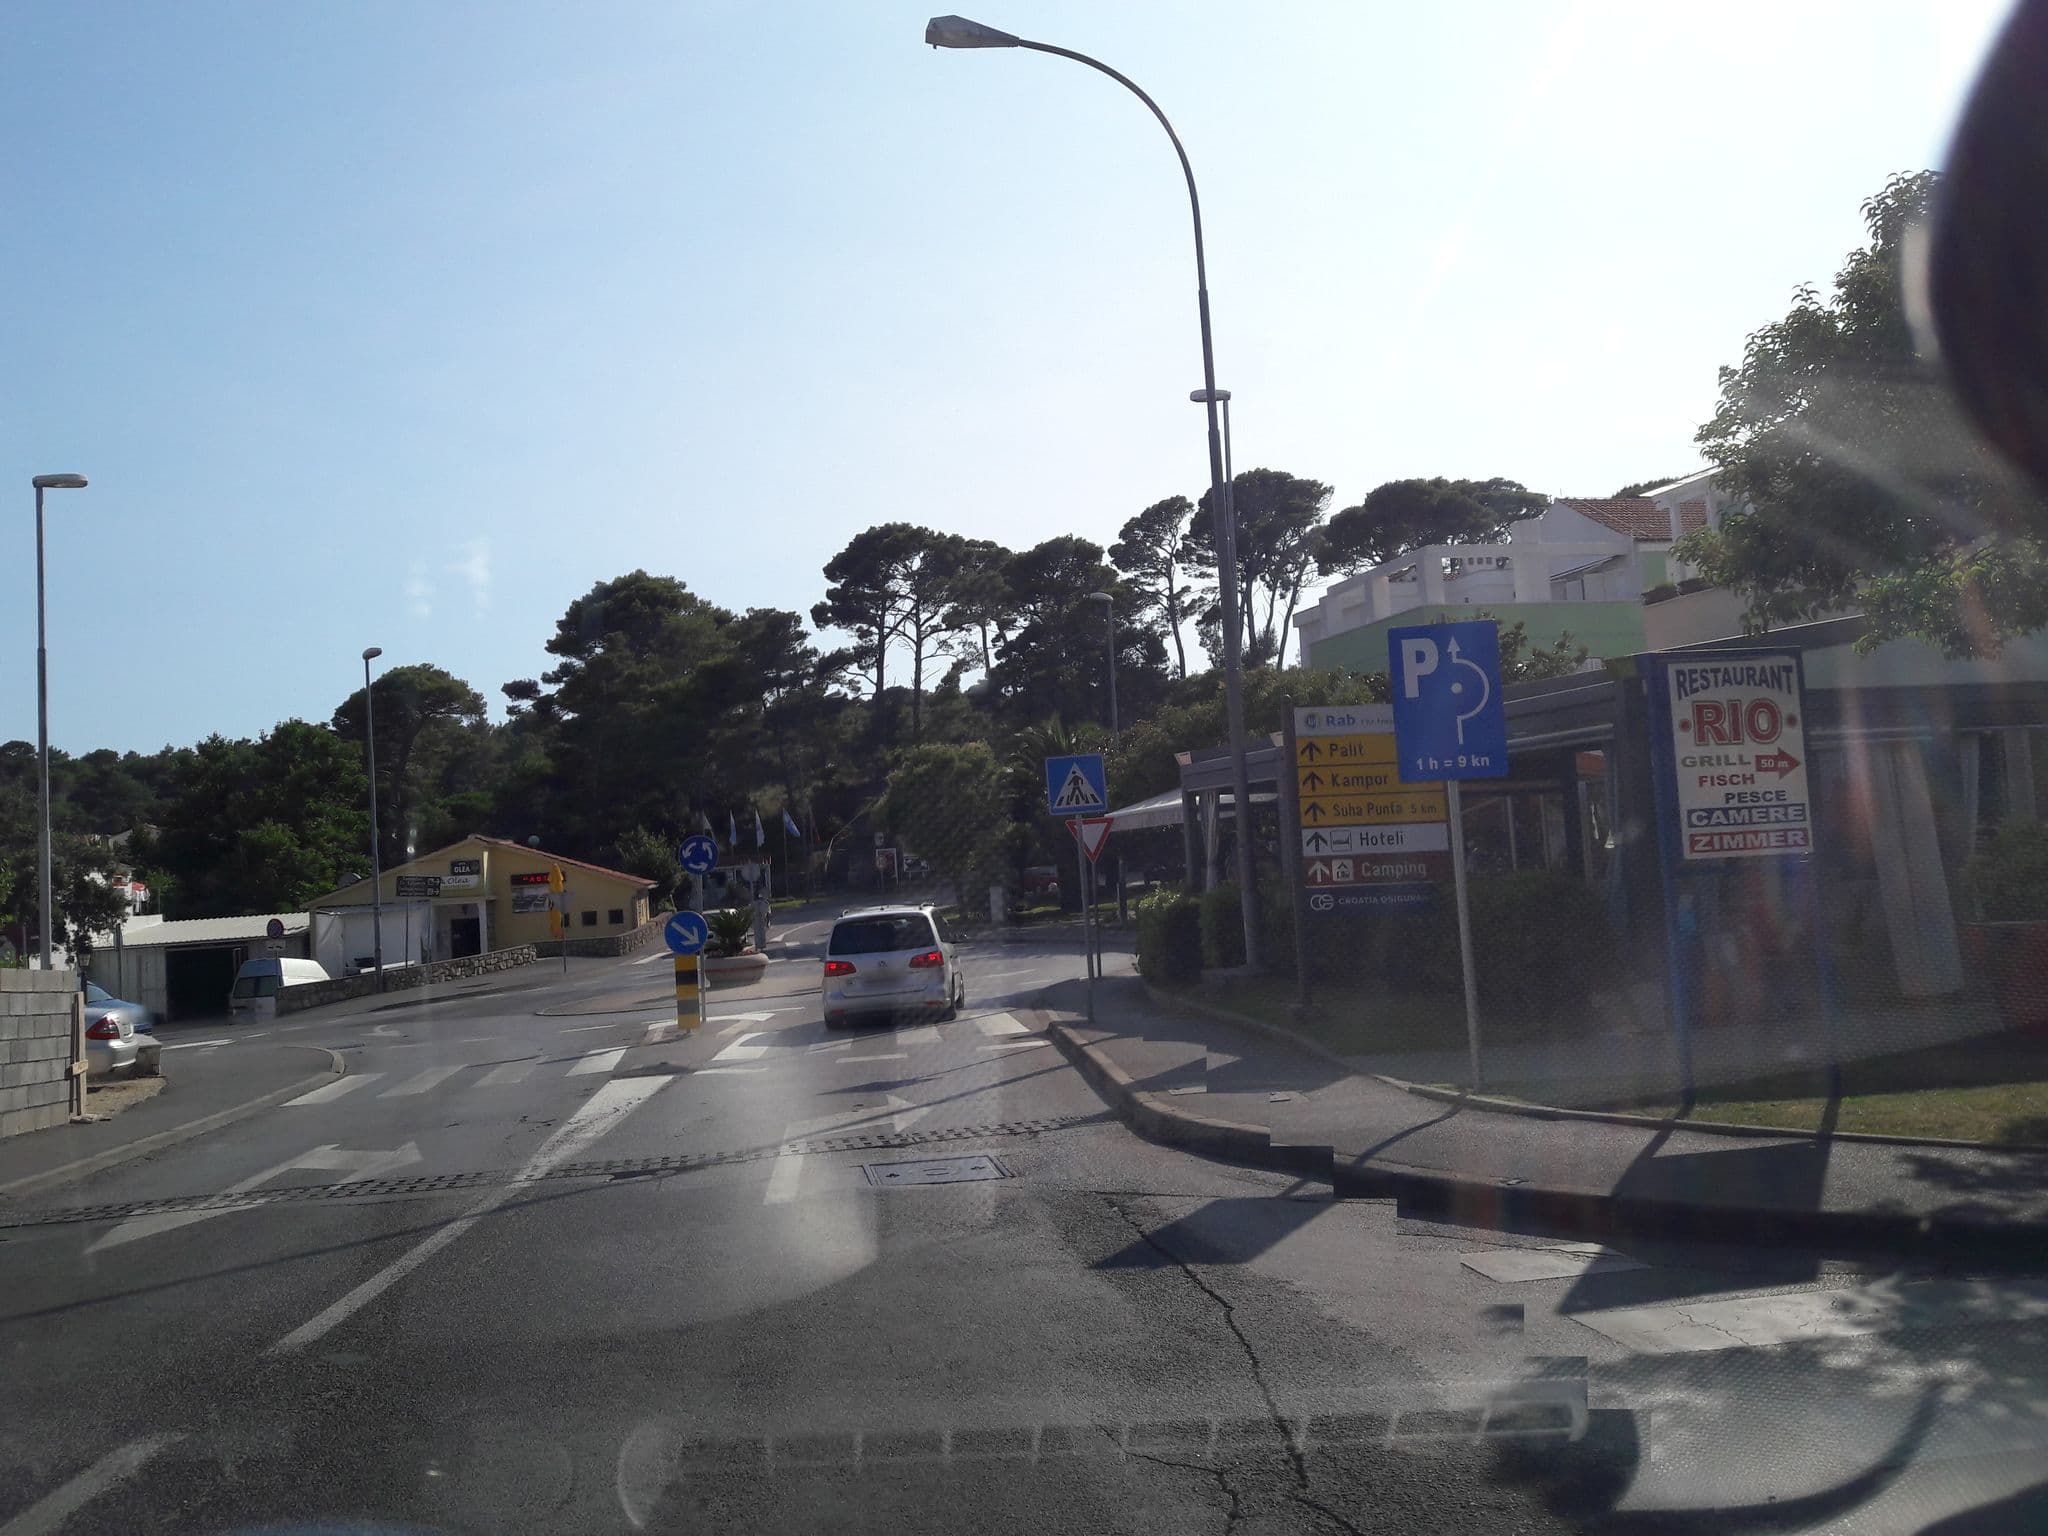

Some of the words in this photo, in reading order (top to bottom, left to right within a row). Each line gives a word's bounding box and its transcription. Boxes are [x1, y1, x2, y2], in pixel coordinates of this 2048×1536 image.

[1401, 637, 1439, 699] P
[1676, 664, 1794, 701] RESTAURANT
[1326, 713, 1356, 727] Rab
[1692, 697, 1783, 746] RIO
[1329, 742, 1364, 757] Palit
[1416, 758, 1424, 770] 1
[1429, 757, 1438, 770] h
[1457, 756, 1467, 768] 9
[1471, 754, 1490, 768] kn
[1681, 753, 1752, 768] GRILL
[1760, 758, 1775, 768] 50
[1778, 759, 1789, 768] m
[1331, 771, 1388, 789] Kampor
[1698, 773, 1756, 788] FISCH
[1725, 789, 1787, 804] PESCE
[1333, 802, 1363, 817] Suha
[1367, 801, 1403, 816] Punta
[1420, 803, 1437, 814] km
[1690, 806, 1803, 826] CAMERE
[1360, 830, 1404, 847] Hoteli
[1694, 830, 1807, 852] ZIMMER
[1361, 861, 1427, 880] Camping
